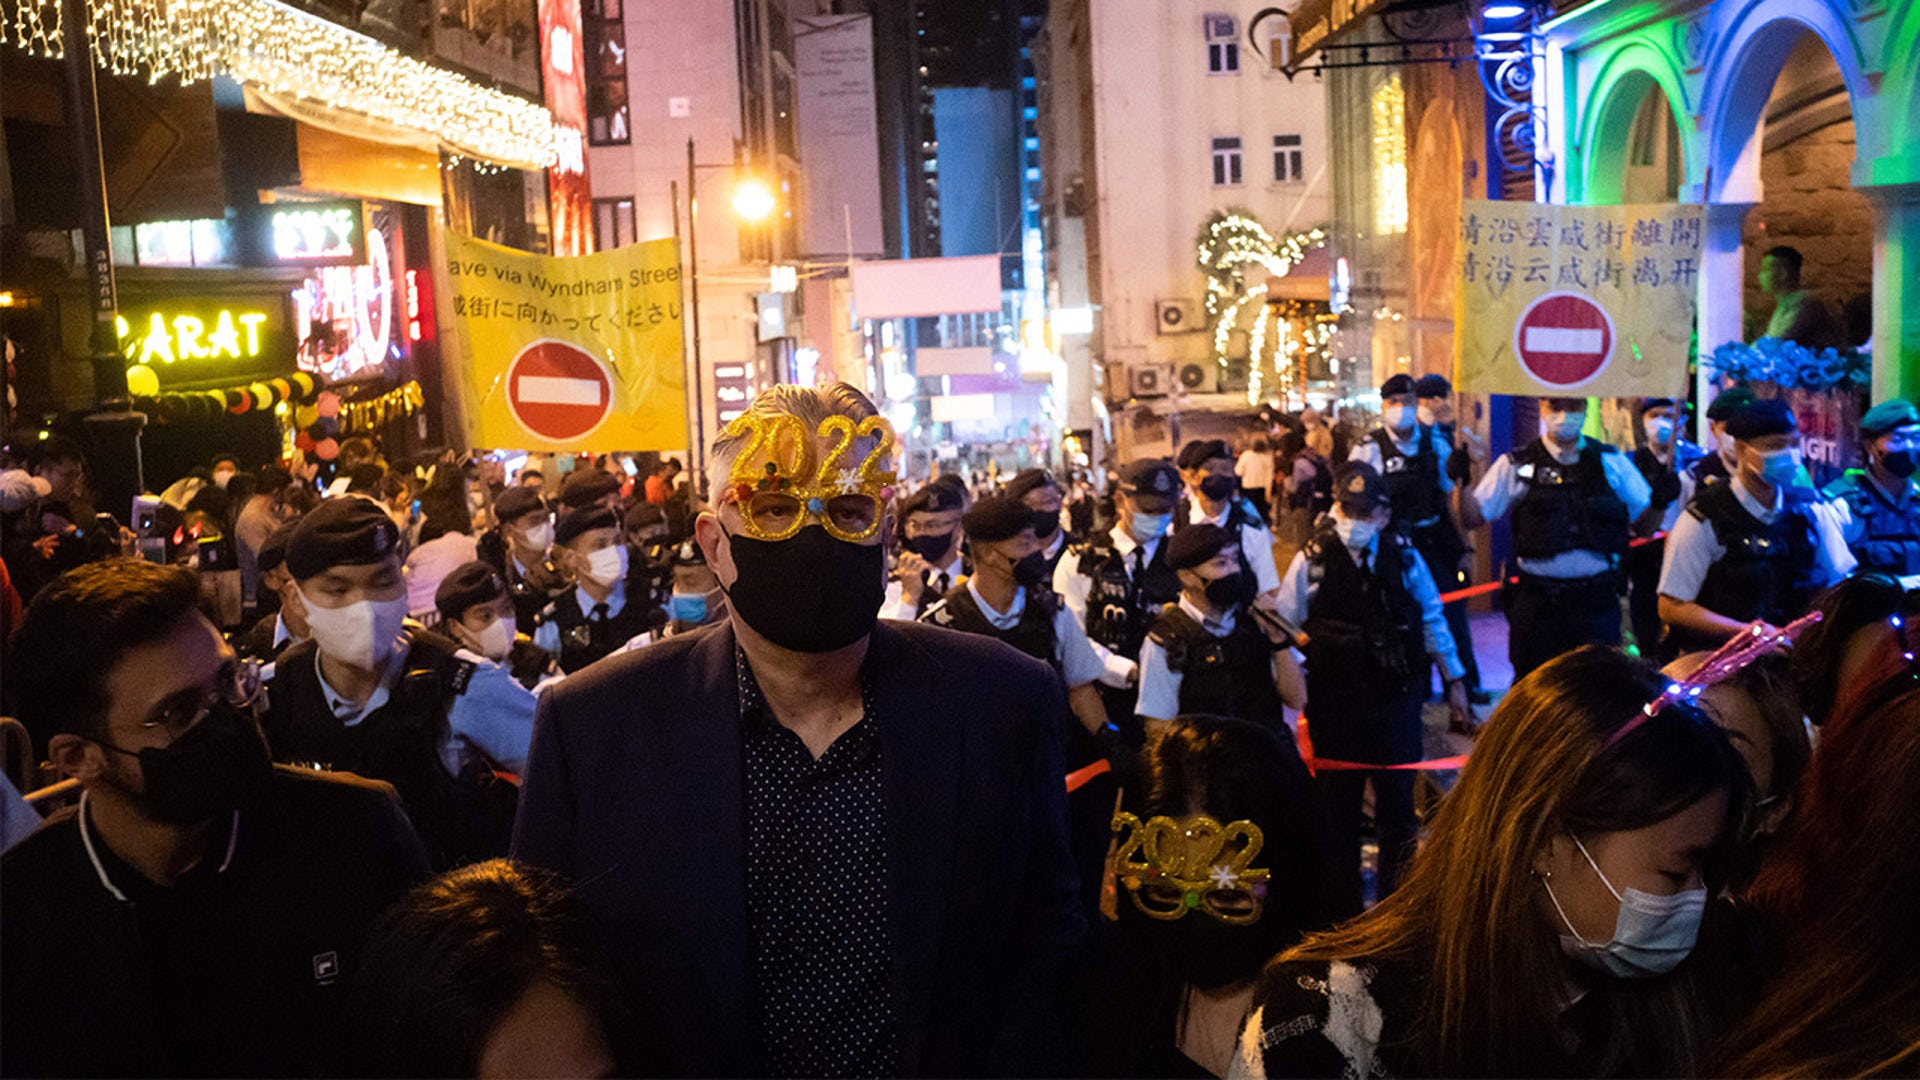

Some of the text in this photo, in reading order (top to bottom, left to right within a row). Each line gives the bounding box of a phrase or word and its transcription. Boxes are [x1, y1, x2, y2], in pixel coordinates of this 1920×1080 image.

[494, 264, 521, 284] via
[528, 271, 623, 298] Wyndham
[727, 414, 897, 486] 2022
[1111, 811, 1270, 880] 2022
